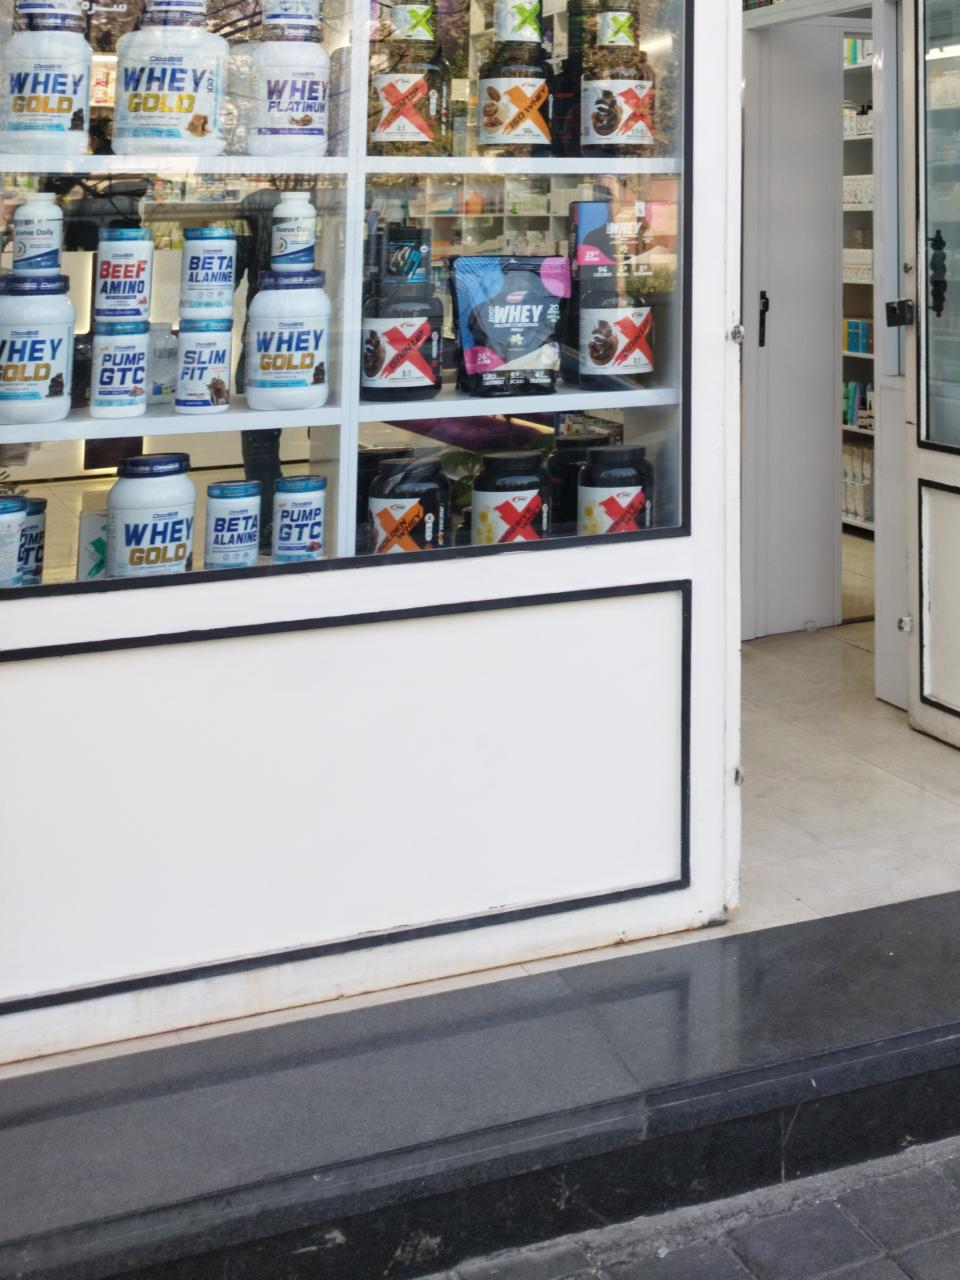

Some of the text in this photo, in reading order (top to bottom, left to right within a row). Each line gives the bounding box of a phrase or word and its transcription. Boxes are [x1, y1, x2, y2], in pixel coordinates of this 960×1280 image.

[9, 71, 84, 95] WHEY
[123, 66, 208, 93] WHEY
[266, 79, 329, 101] WHEY
[523, 86, 546, 113] WHEY
[12, 95, 74, 114] GOLD
[128, 93, 196, 113] GOLD
[267, 101, 326, 114] PLATINUM
[99, 260, 147, 279] BEEF
[189, 256, 233, 270] BETA
[188, 271, 233, 283] ALANINE
[100, 280, 145, 294] AMINO
[494, 304, 544, 324] WHEY
[256, 329, 325, 353] WHEY
[101, 352, 145, 367] PUMP
[183, 349, 227, 365] SLIM
[259, 353, 316, 371] GOLD
[98, 366, 145, 386] GTC
[181, 367, 208, 381] FIT
[213, 513, 258, 533] BETA
[280, 507, 321, 523] PUMP
[124, 516, 194, 547] WHEY
[213, 530, 258, 546] ALANINE
[278, 520, 321, 542] GTC
[128, 542, 188, 567] GOLD
